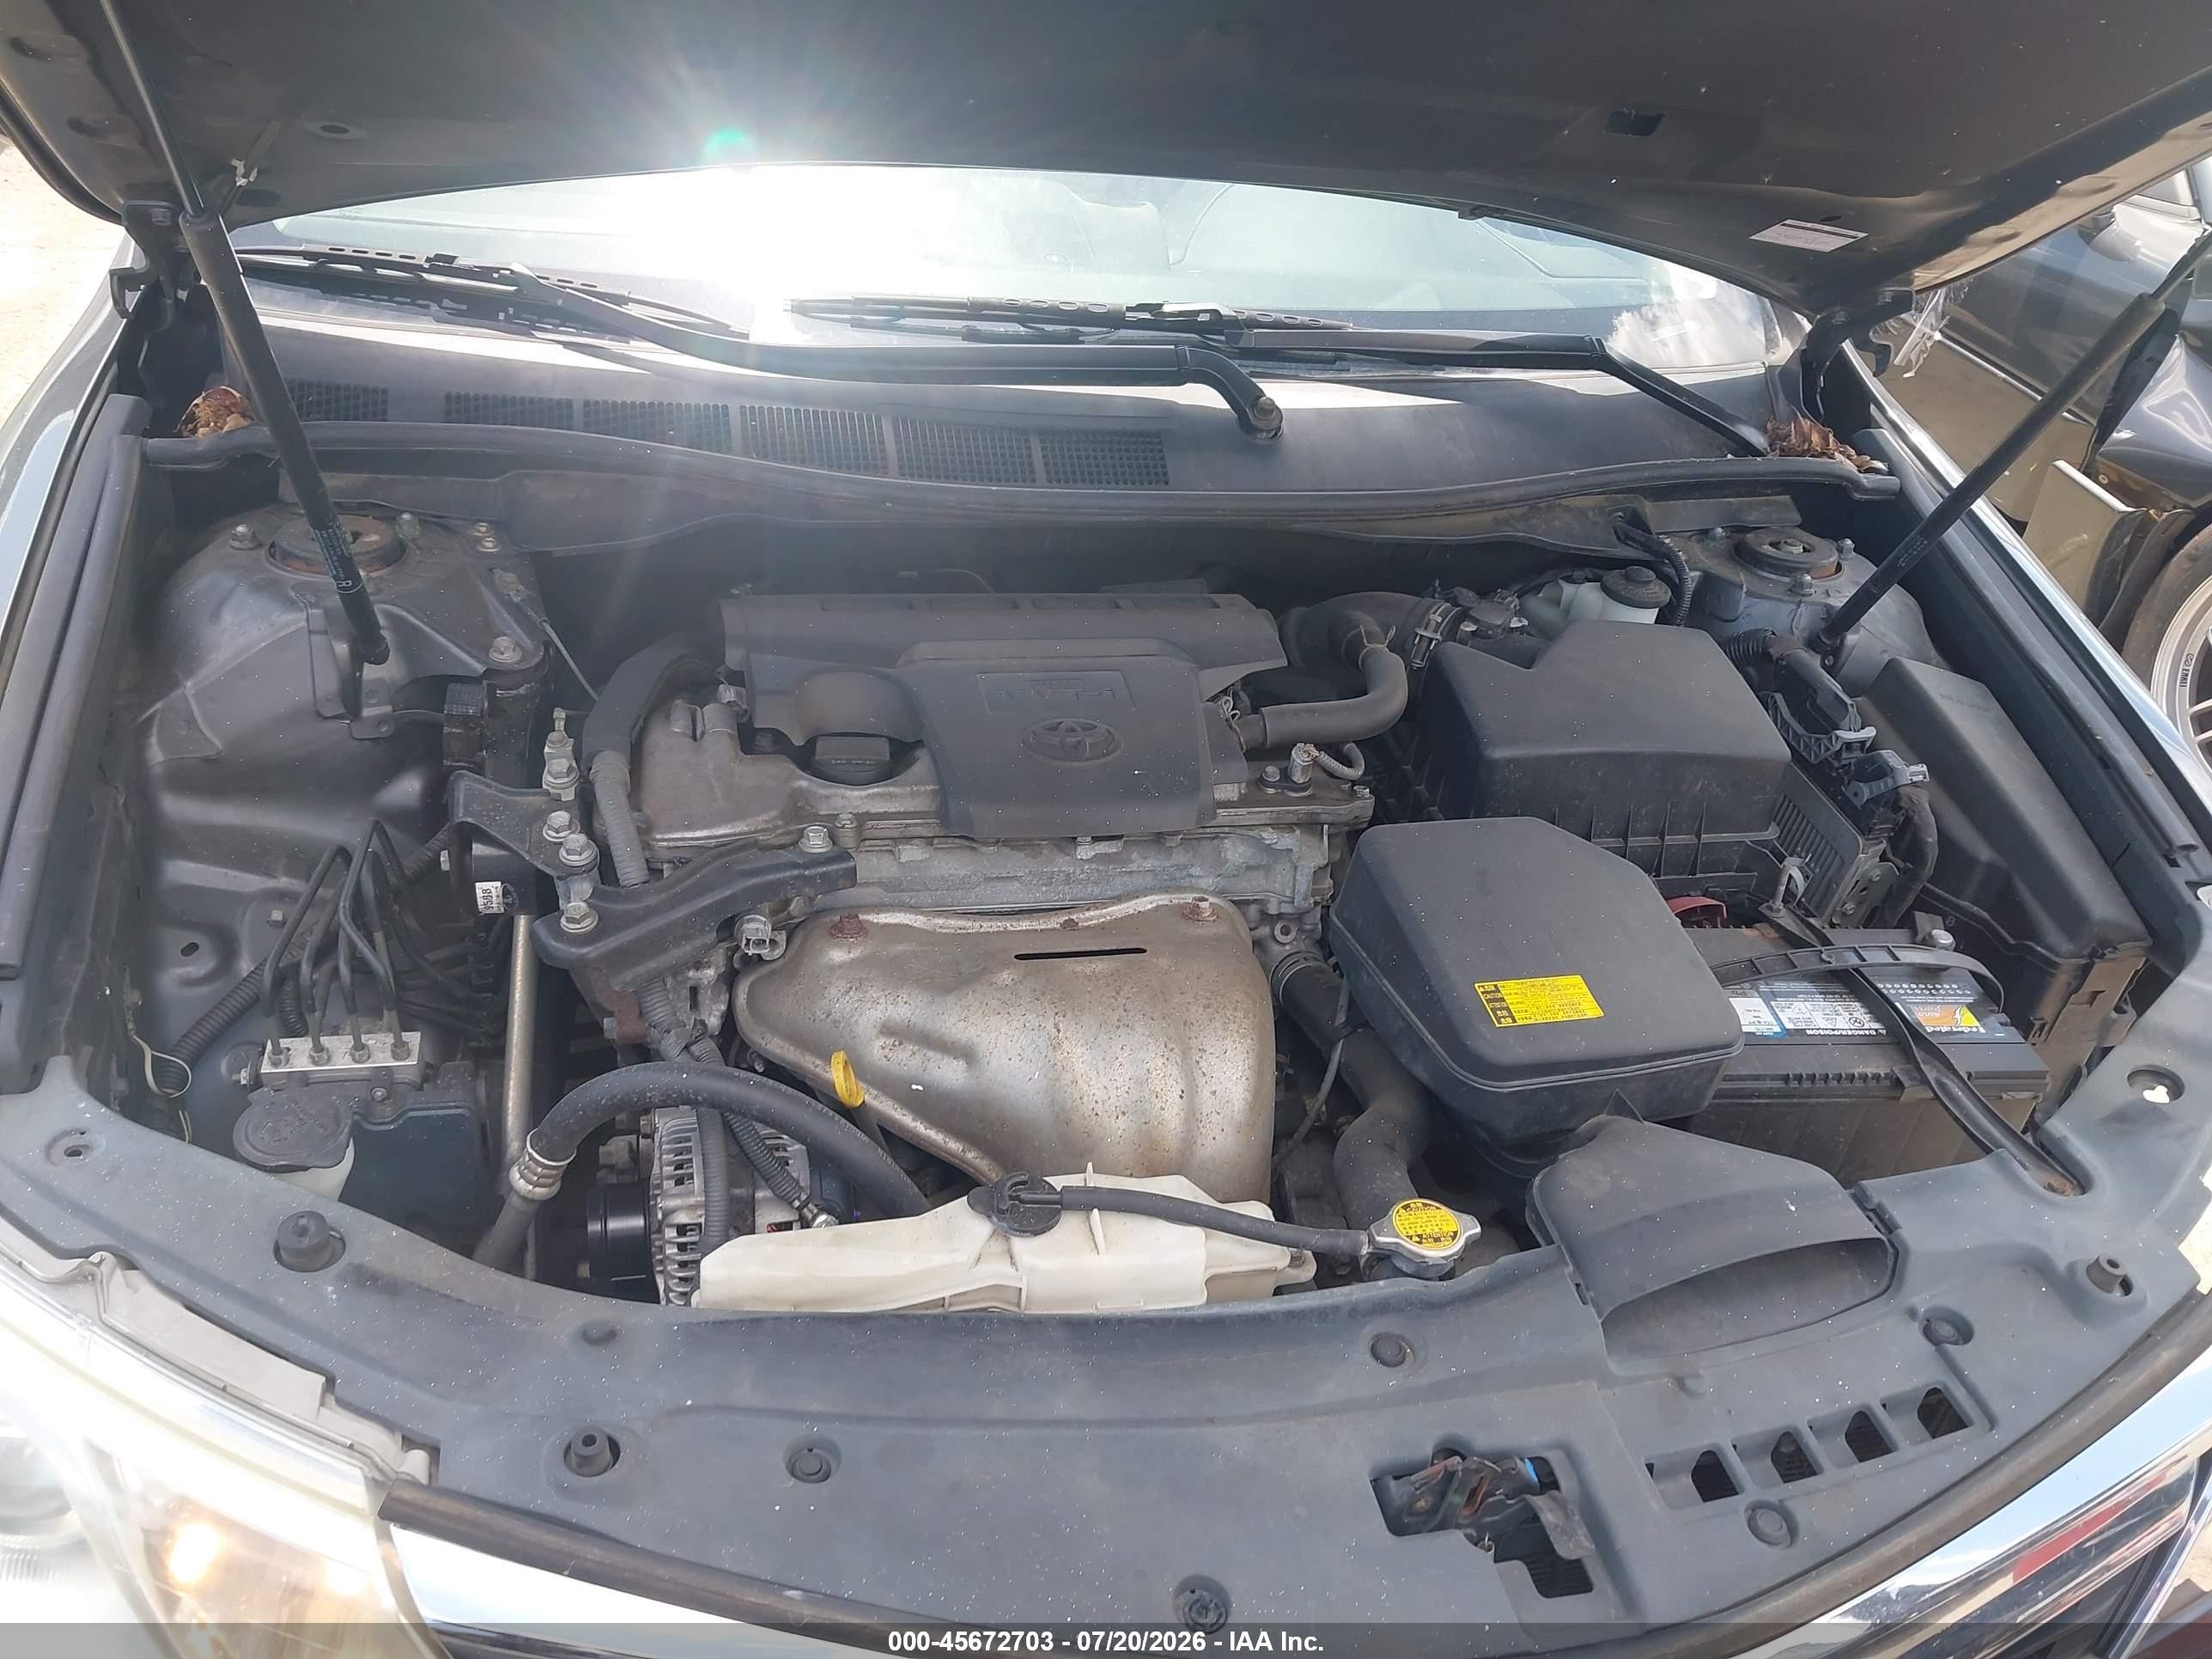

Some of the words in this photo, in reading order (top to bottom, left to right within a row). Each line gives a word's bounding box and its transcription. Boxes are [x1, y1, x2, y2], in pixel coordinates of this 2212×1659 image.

[2179, 668, 2191, 688] ENKEI
[1805, 1028, 1877, 1036] DANGER/POISON
[1924, 1025, 1986, 1034] Federated
